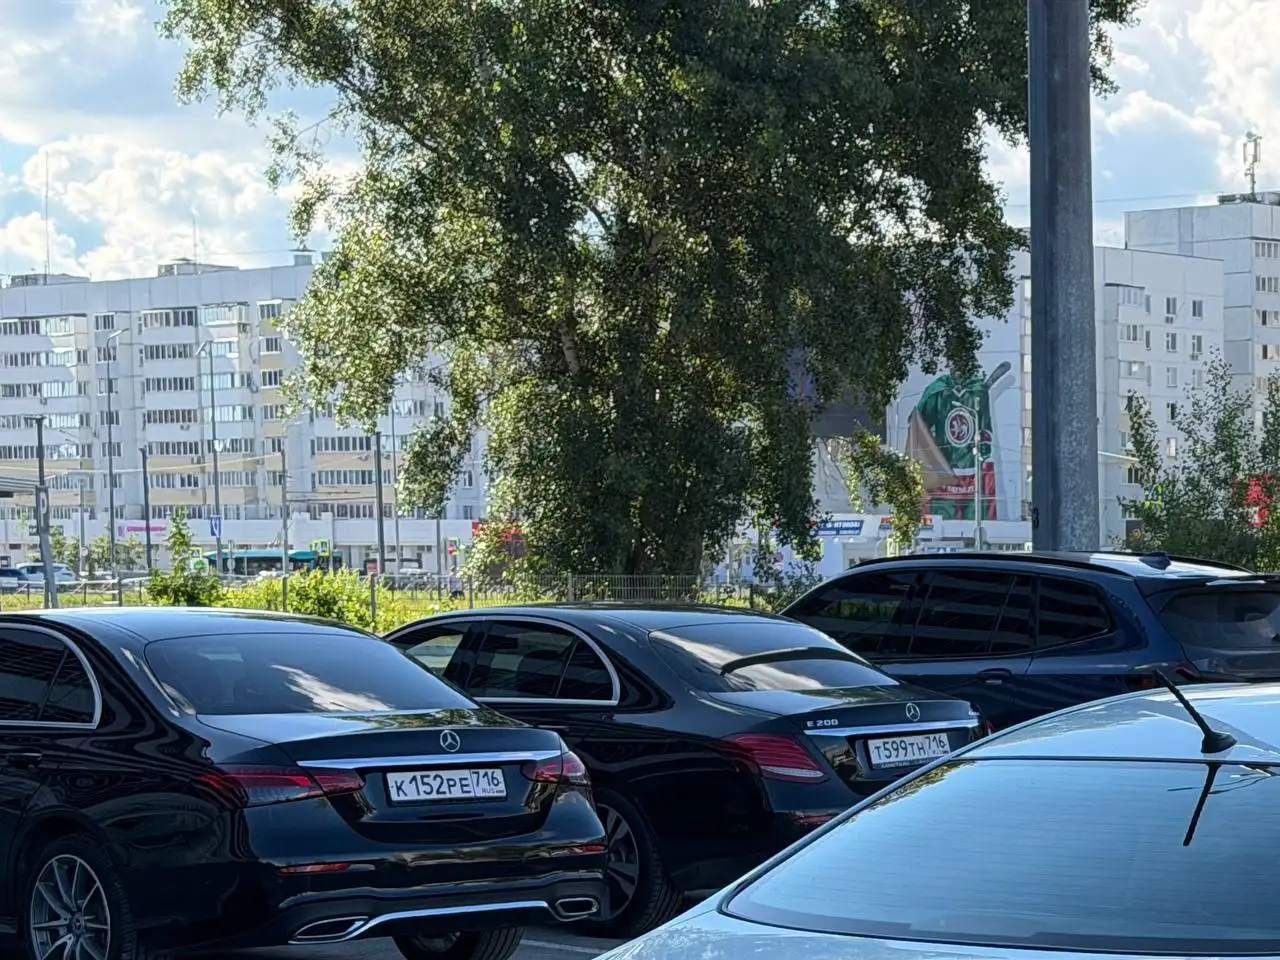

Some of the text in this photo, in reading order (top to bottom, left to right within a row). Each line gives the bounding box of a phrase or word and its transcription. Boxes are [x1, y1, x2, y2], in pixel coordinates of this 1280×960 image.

[816, 718, 839, 727] 200
[874, 736, 947, 760] Т599ТН 716
[394, 770, 501, 797] К152РЕ 716
